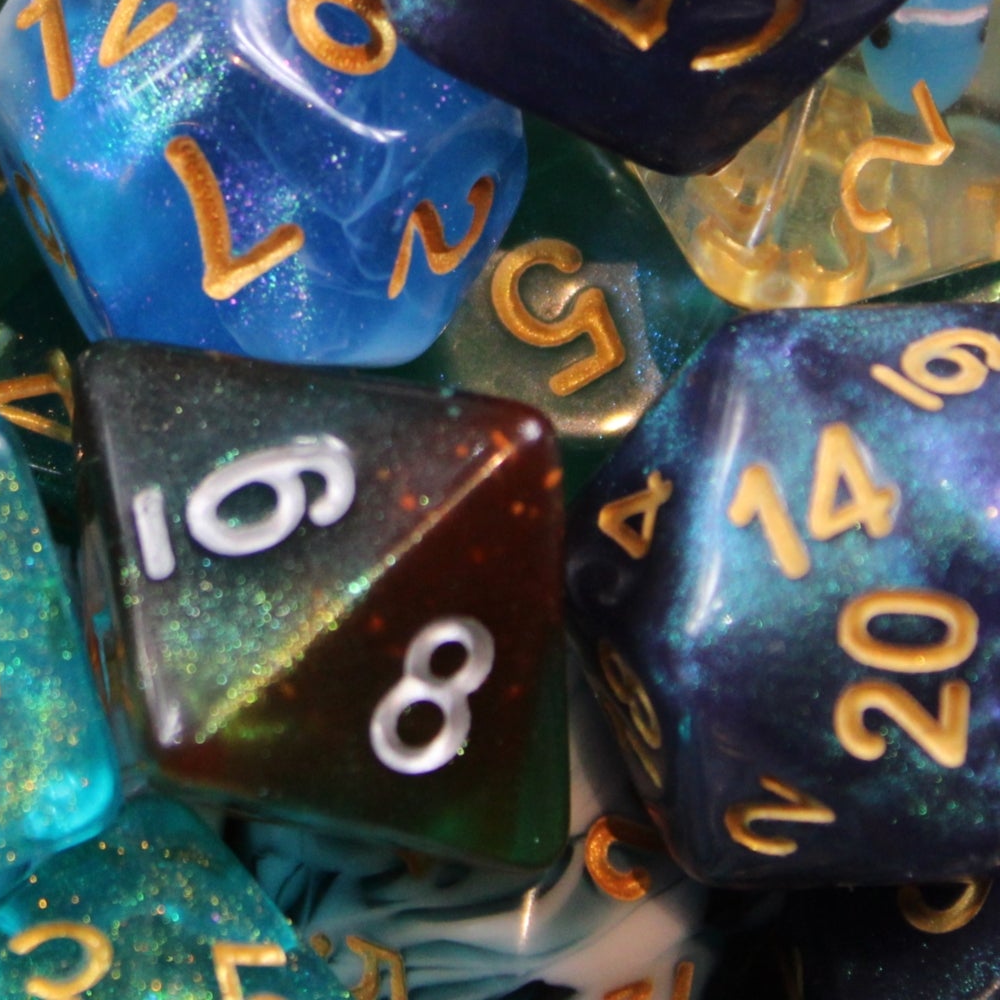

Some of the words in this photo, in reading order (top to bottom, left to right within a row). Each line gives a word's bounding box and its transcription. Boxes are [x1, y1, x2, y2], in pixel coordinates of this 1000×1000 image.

[164, 135, 305, 301] 7
[840, 79, 955, 233] 2
[387, 175, 496, 300] 2
[490, 237, 626, 397] 5
[597, 468, 674, 560] 4
[727, 422, 900, 580] 14
[368, 615, 497, 776] 8
[832, 590, 981, 770] 20
[724, 775, 837, 857] 2
